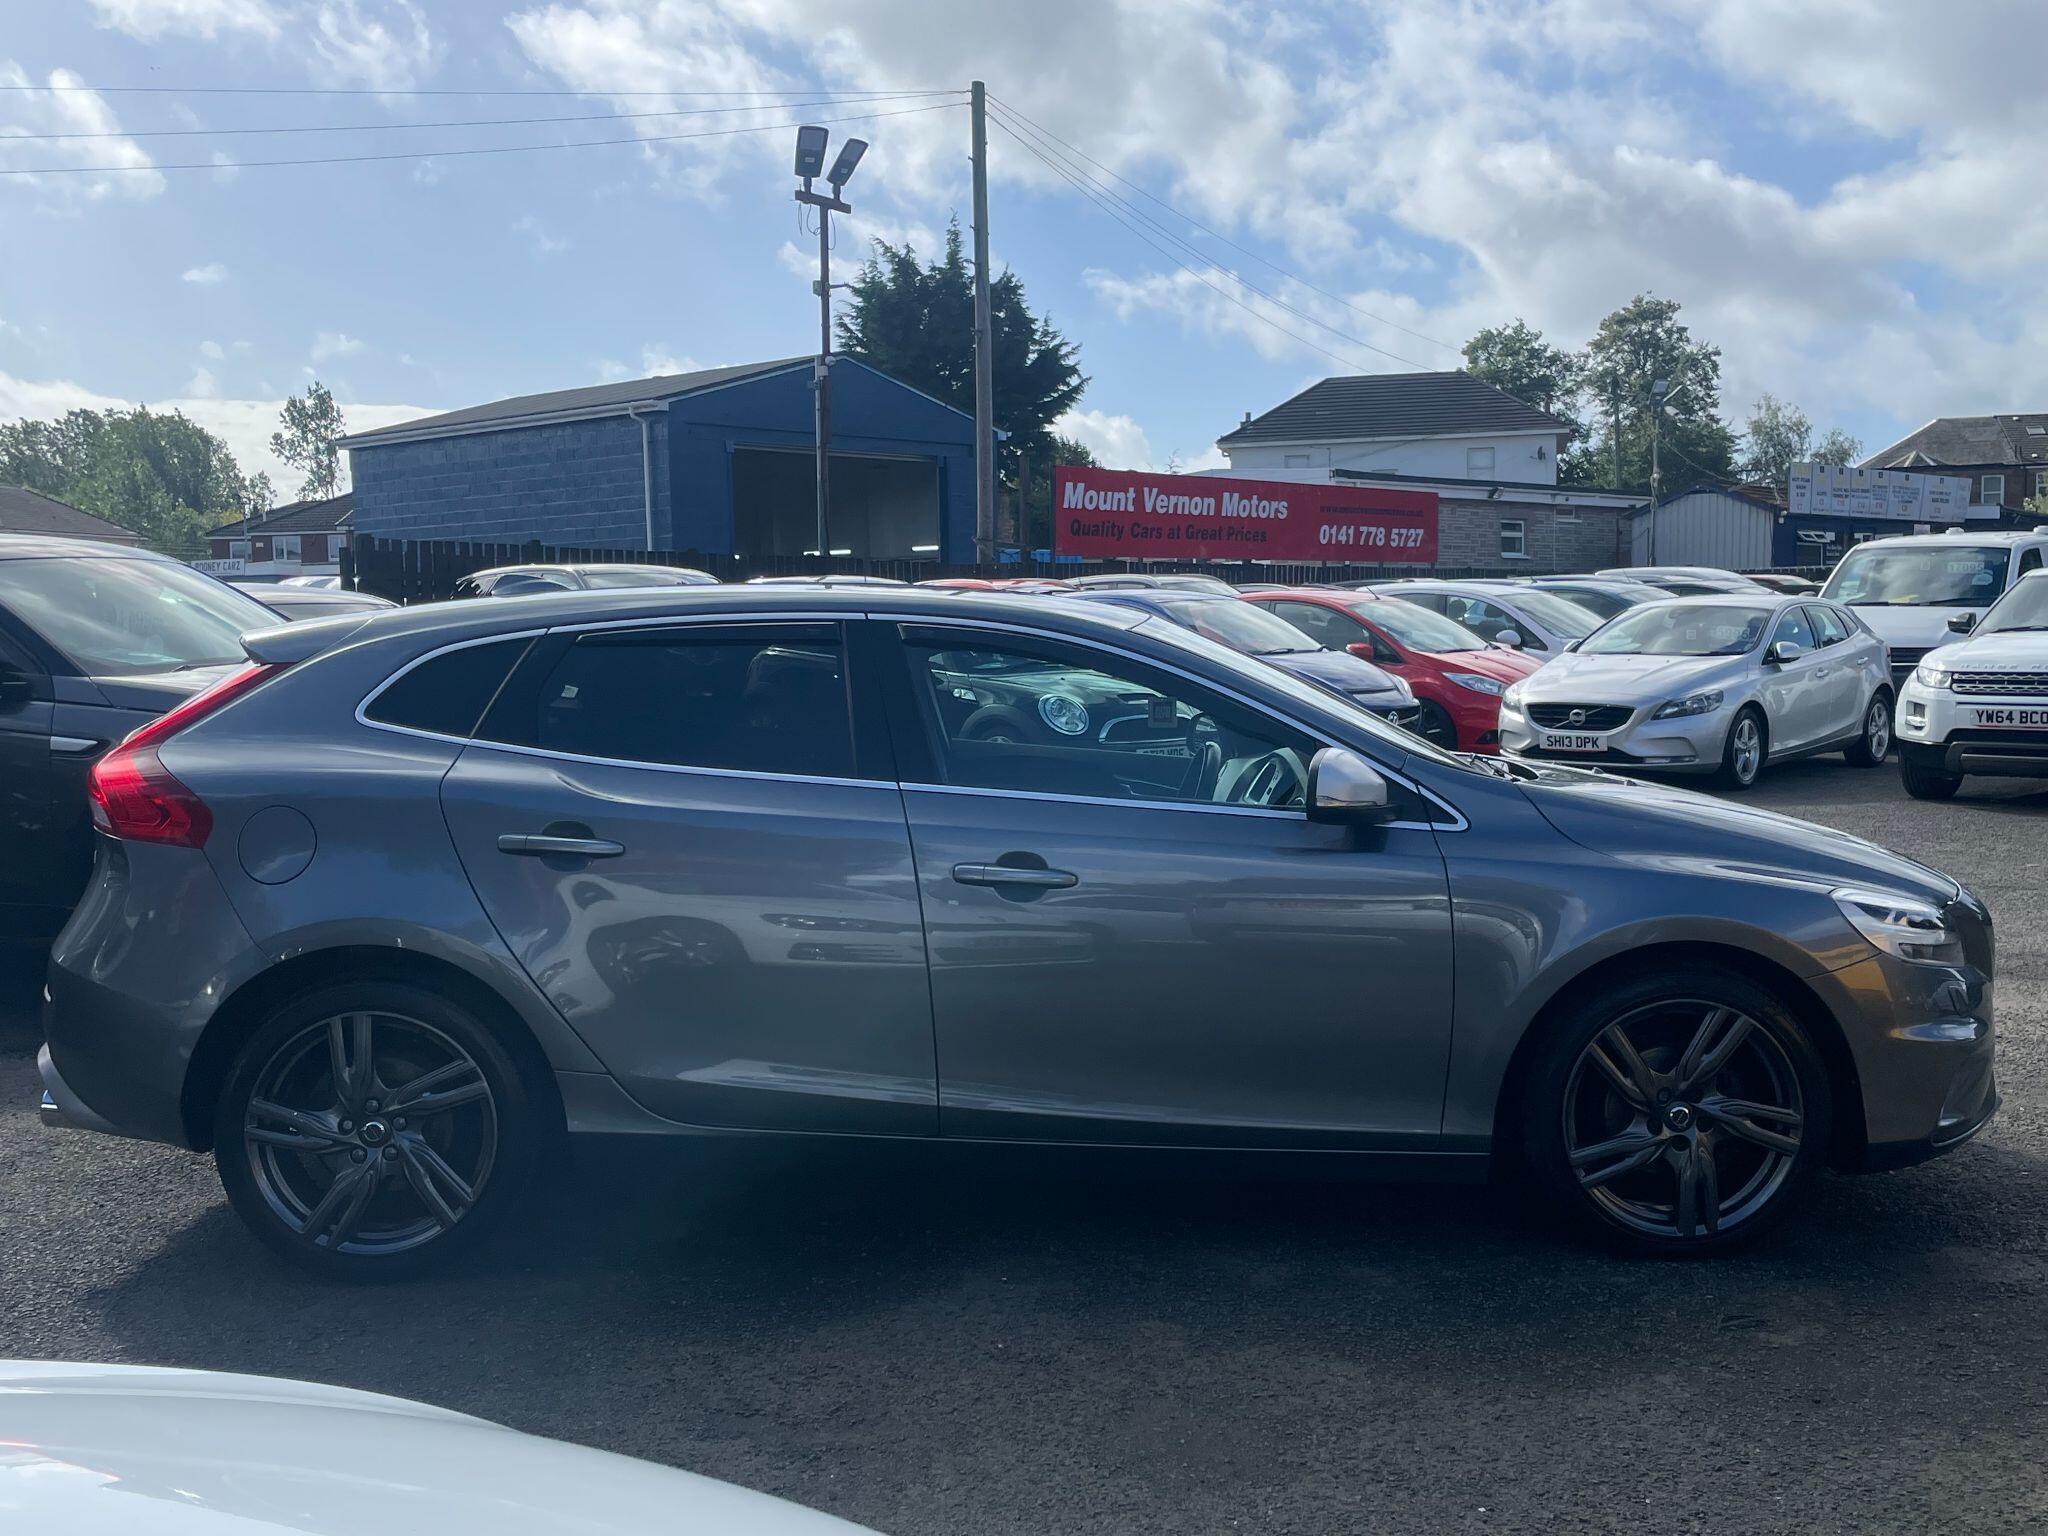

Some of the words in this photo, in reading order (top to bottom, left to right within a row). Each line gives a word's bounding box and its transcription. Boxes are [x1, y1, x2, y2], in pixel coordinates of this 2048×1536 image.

[1063, 481, 1136, 513] Mount
[1143, 487, 1215, 516] Vernon
[1221, 491, 1289, 520] Motors
[1070, 519, 1124, 541] Quality
[1130, 522, 1162, 539] Cars
[1167, 522, 1181, 539] at
[1186, 524, 1222, 541] Great
[1227, 526, 1267, 543] Prices
[1319, 525, 1355, 545] 0141
[1359, 526, 1386, 546] 778
[1390, 528, 1424, 547] 5727
[223, 561, 241, 571] CARZ
[1976, 709, 2015, 724] YW64
[1546, 735, 1573, 748] SH13
[1576, 736, 1600, 749] DPK
